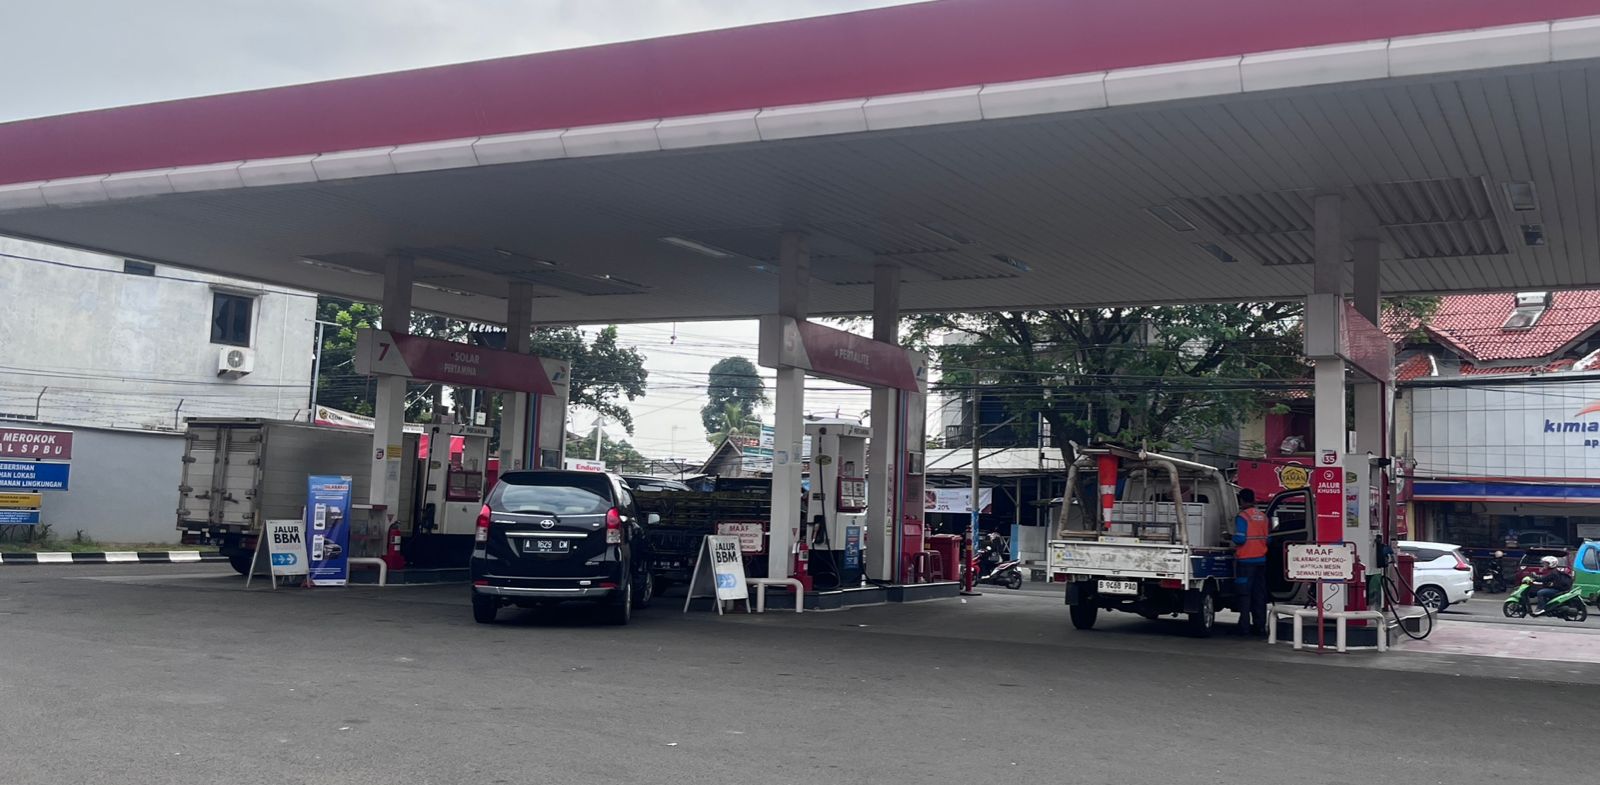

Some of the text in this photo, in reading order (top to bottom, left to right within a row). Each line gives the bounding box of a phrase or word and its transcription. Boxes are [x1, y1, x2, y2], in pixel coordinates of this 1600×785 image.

[379, 342, 391, 361] 7
[455, 351, 480, 364] SOLAR
[1543, 418, 1600, 433] kimia
[3, 432, 56, 444] MEROKOK
[575, 463, 601, 472] Enduro
[22, 480, 63, 488] LINGKUNGAN
[273, 533, 301, 544] BBM
[525, 540, 530, 548] A
[715, 543, 737, 551] JALUR
[716, 551, 739, 563] BBM
[1306, 548, 1334, 556] MAAF
[1099, 581, 1105, 589] B
